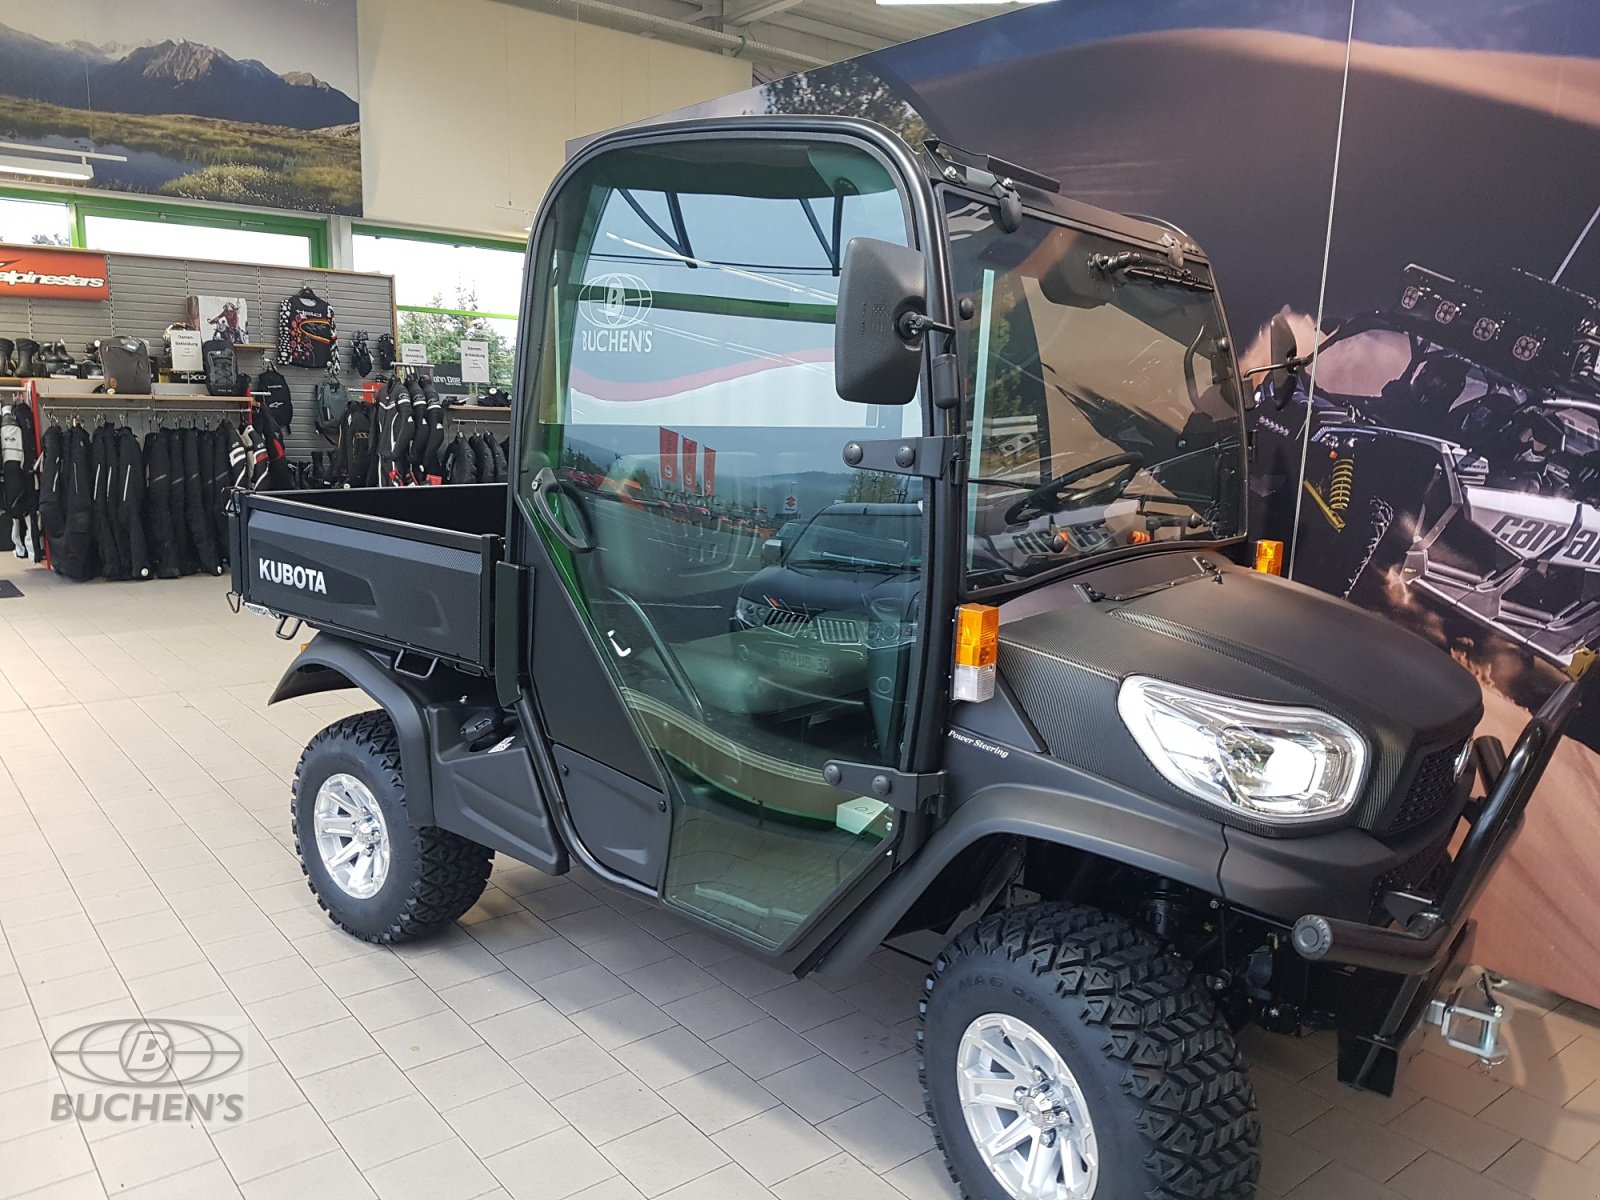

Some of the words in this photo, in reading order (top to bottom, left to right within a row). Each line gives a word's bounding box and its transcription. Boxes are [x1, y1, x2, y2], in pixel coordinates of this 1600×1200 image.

[0, 269, 105, 288] alpinestars
[581, 329, 653, 353] BUCHEN'S
[259, 557, 328, 595] KUBOTA
[947, 729, 974, 744] Power
[973, 739, 1009, 759] Steering
